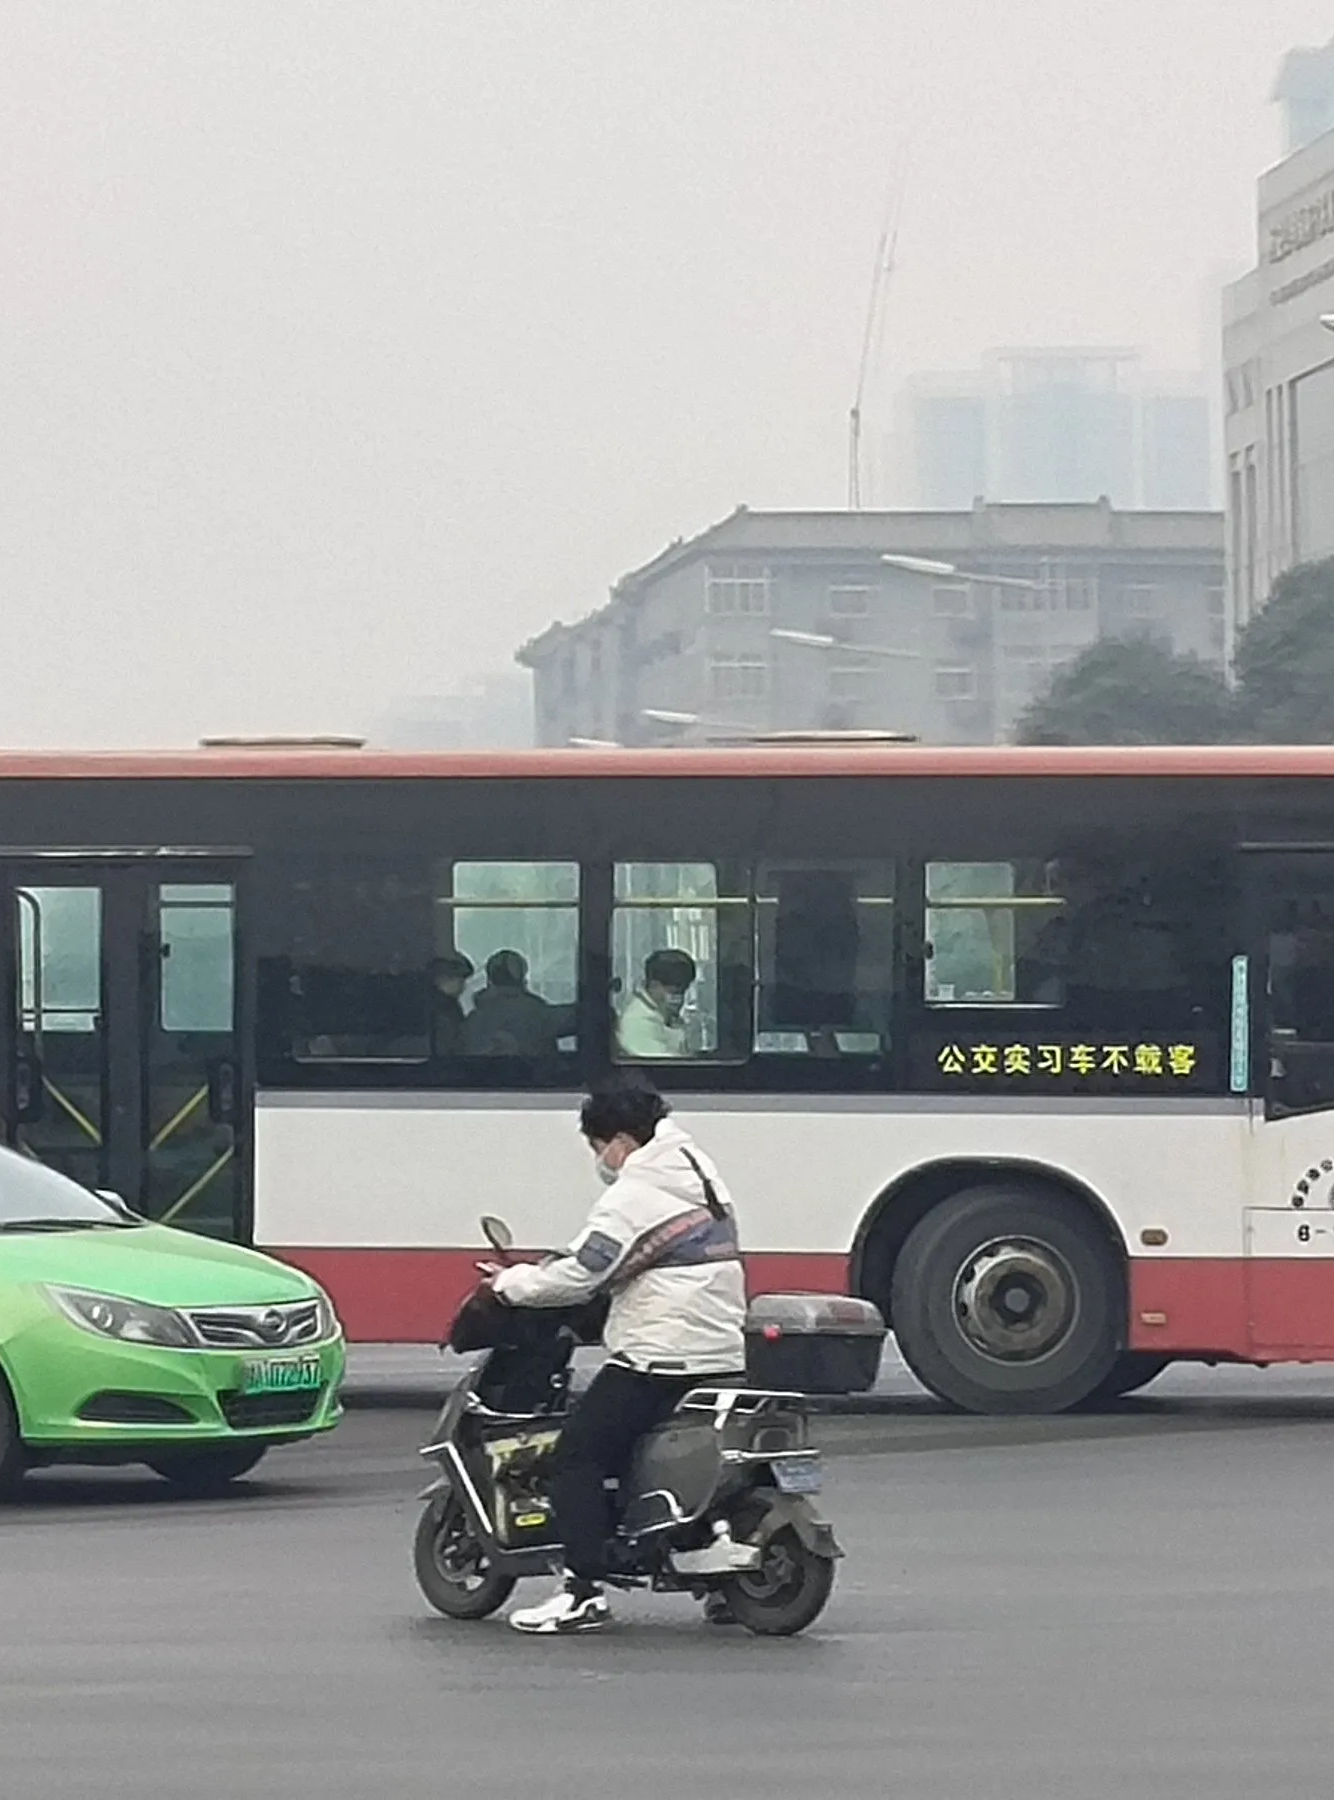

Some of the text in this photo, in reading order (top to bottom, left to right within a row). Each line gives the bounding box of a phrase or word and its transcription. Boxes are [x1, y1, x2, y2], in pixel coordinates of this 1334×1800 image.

[937, 1043, 1197, 1075] 公交实习车不载客
